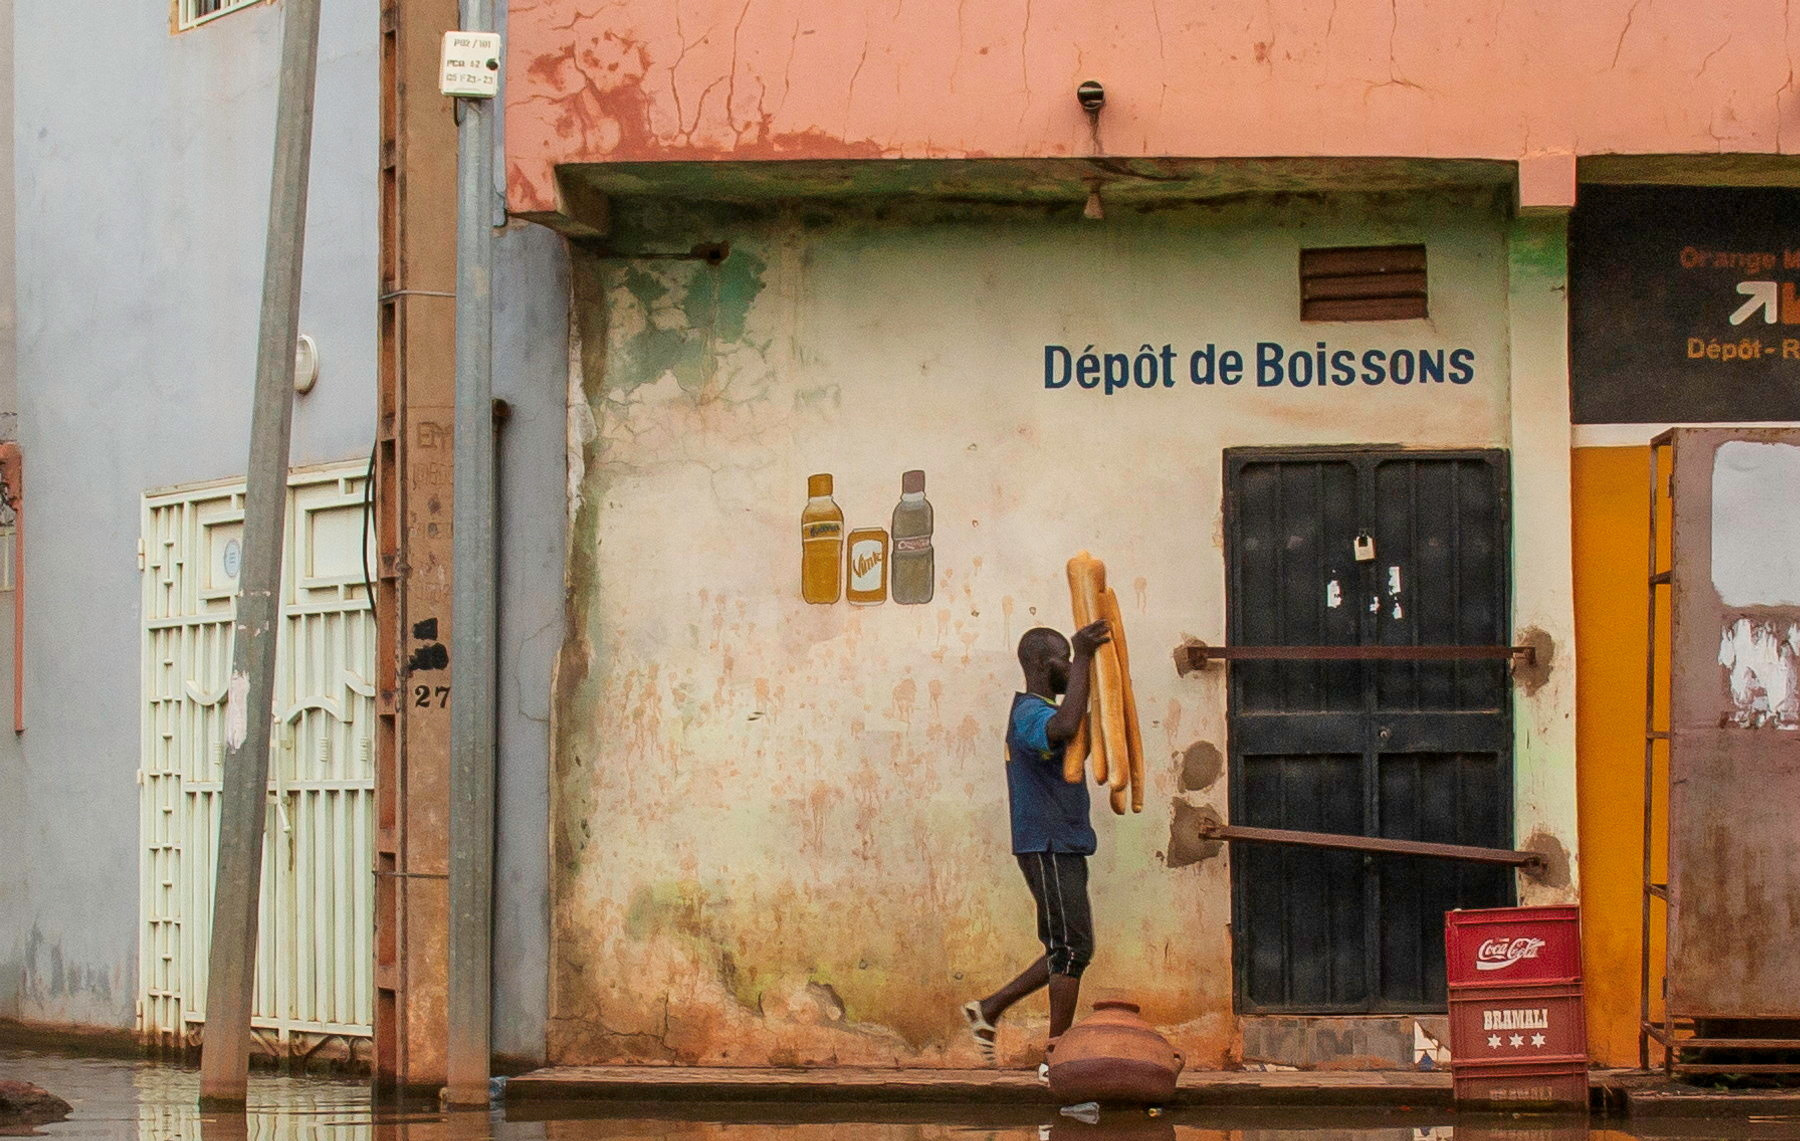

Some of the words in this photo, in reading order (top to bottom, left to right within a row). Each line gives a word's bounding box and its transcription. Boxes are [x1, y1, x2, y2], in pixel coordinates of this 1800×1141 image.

[1680, 246, 1777, 274] Orange
[1687, 337, 1762, 362] Dépôt
[1044, 344, 1178, 395] Dépôt
[1190, 344, 1244, 385] de
[415, 684, 450, 708] 27
[1484, 1009, 1548, 1030] BRAMALI
